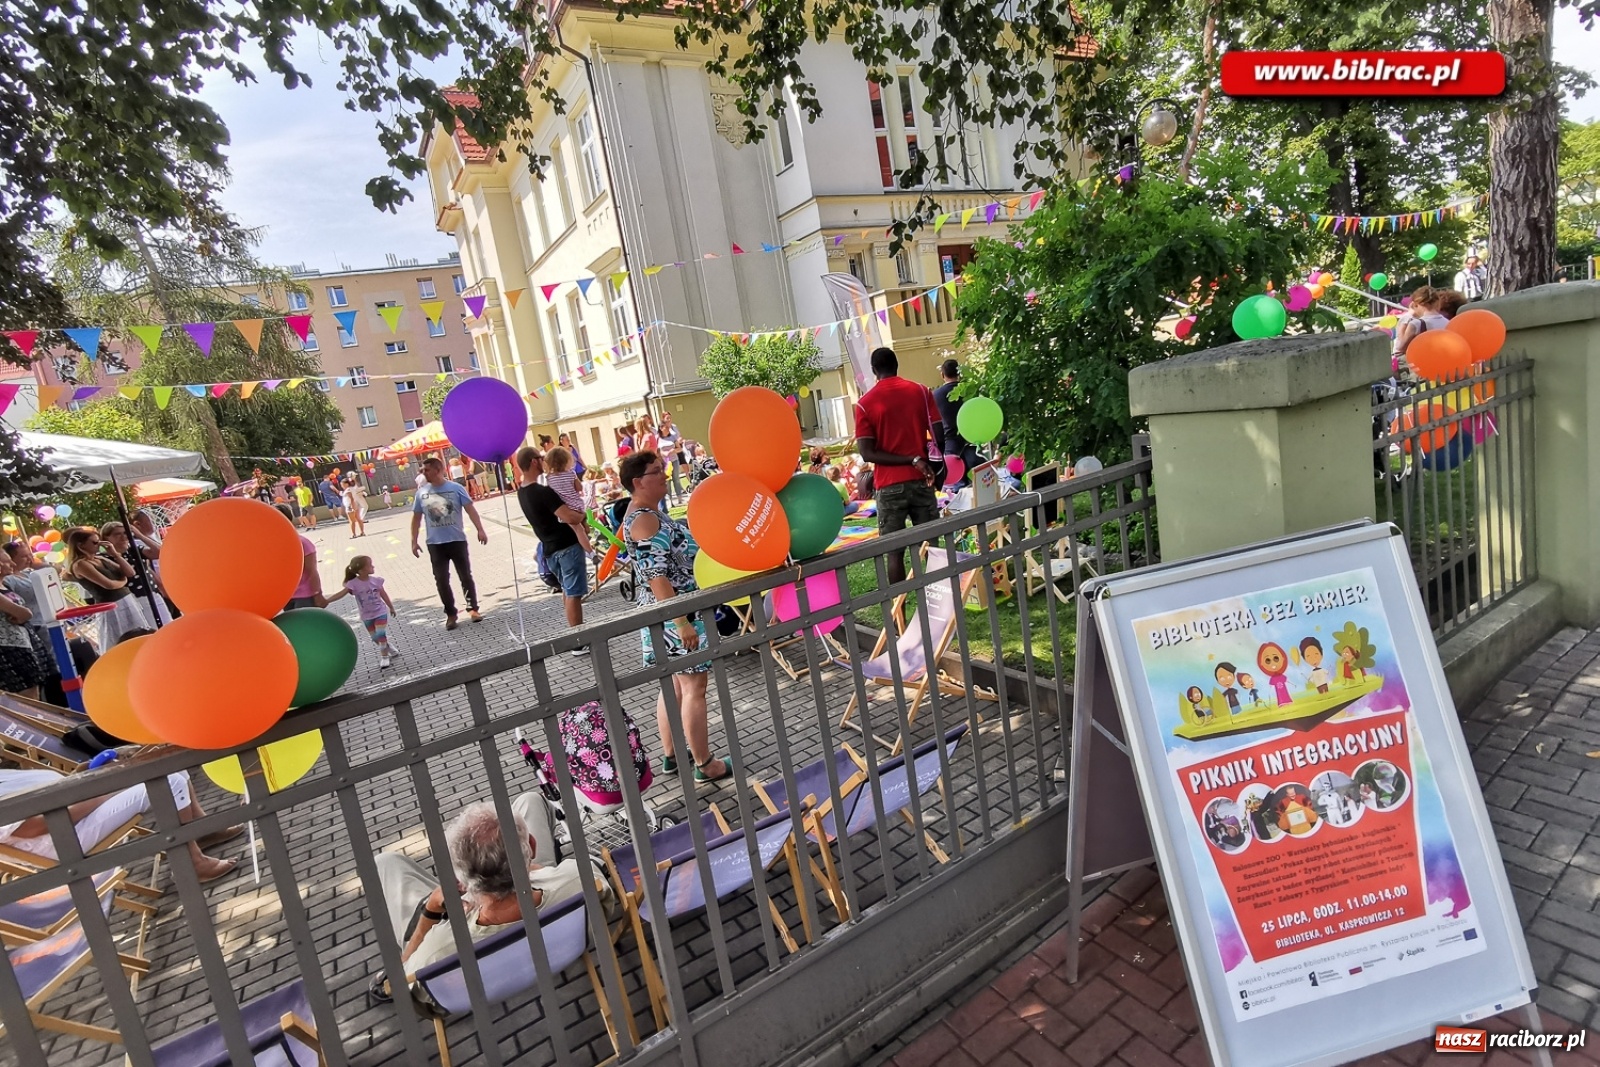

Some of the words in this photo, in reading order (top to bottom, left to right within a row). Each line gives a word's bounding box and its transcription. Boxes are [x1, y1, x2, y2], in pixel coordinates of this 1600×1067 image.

[735, 492, 764, 534] BIBLIOTEKA
[742, 535, 751, 544] W
[1150, 608, 1257, 650] BIBLIOTEKA
[1261, 600, 1298, 624] BEZ
[1300, 583, 1369, 616] BARIER
[1188, 757, 1258, 795] PIKNIK
[1261, 721, 1405, 776] INTEGRACYJNY
[1266, 854, 1281, 864] ZOO
[1261, 919, 1276, 934] 25
[1278, 911, 1311, 931] LIPCA,
[1313, 901, 1344, 920] GODZ.
[1346, 884, 1408, 911] 11.00-14.00
[1275, 930, 1323, 950] BIBLIOTEKA,
[1324, 925, 1337, 936] UL.
[1338, 910, 1393, 932] KASPROWICZA
[1394, 907, 1406, 917] 12
